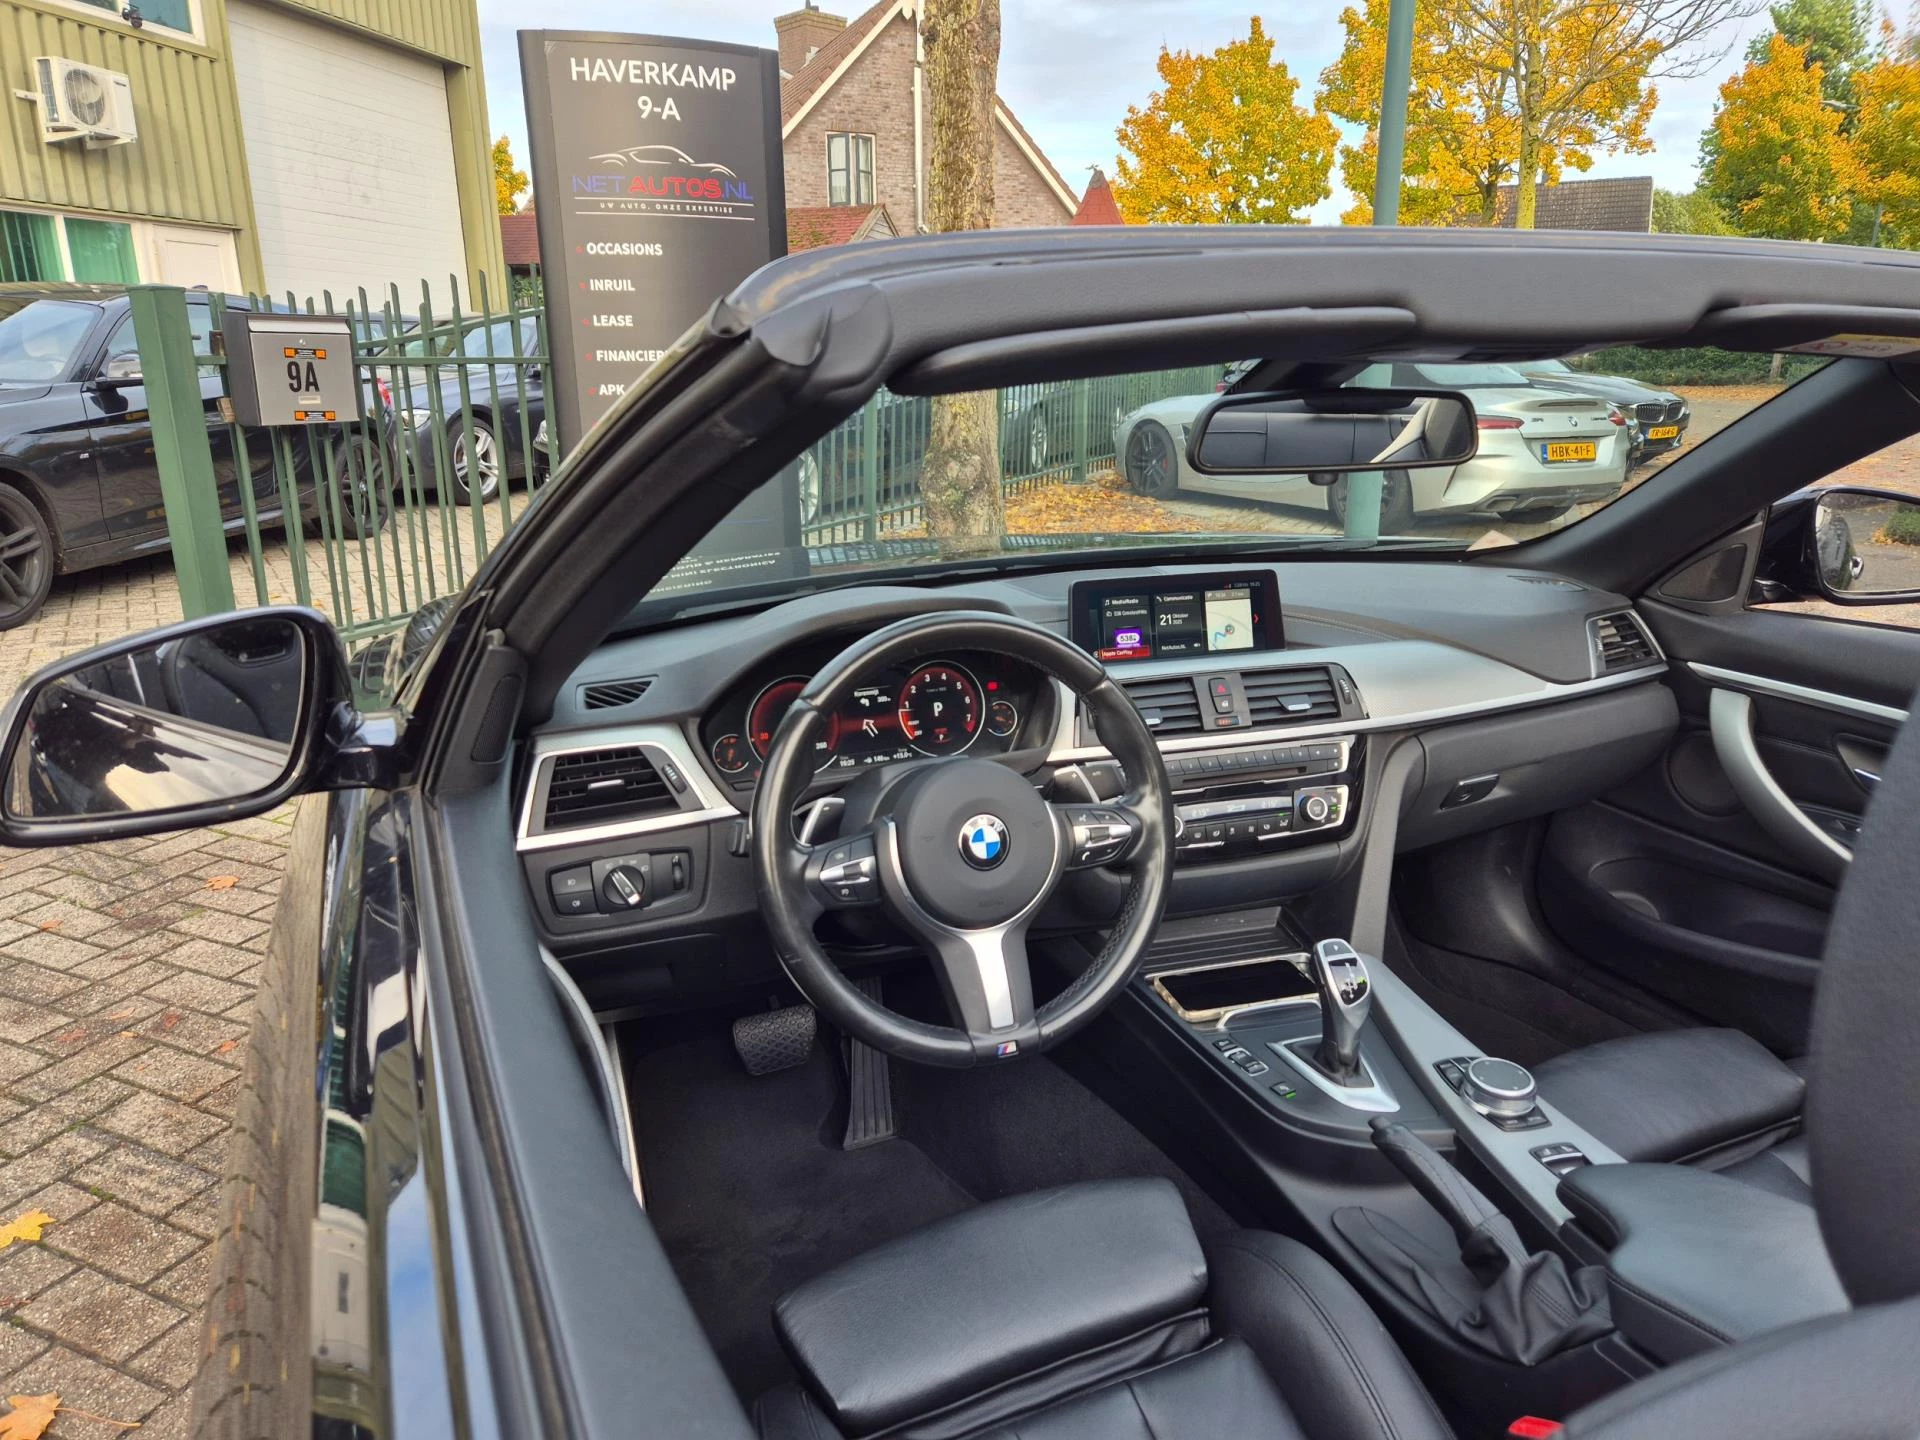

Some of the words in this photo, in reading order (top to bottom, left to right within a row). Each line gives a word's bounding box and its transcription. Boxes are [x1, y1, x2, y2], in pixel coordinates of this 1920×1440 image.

[570, 57, 736, 91] HAVERKAMP
[637, 95, 681, 121] 9-A
[685, 205, 733, 214] EXPERTISE
[586, 242, 663, 256] OCCASIONS
[589, 279, 635, 291] INRUIL
[593, 315, 633, 327] LEASE
[596, 350, 668, 362] FINANCIER
[287, 361, 320, 393] 9A
[600, 384, 625, 396] APK
[1552, 445, 1591, 458] HBK-41-F
[1159, 613, 1172, 626] 21
[924, 674, 930, 682] 3
[940, 672, 947, 680] 4
[964, 696, 970, 704] 6
[933, 701, 943, 717] P
